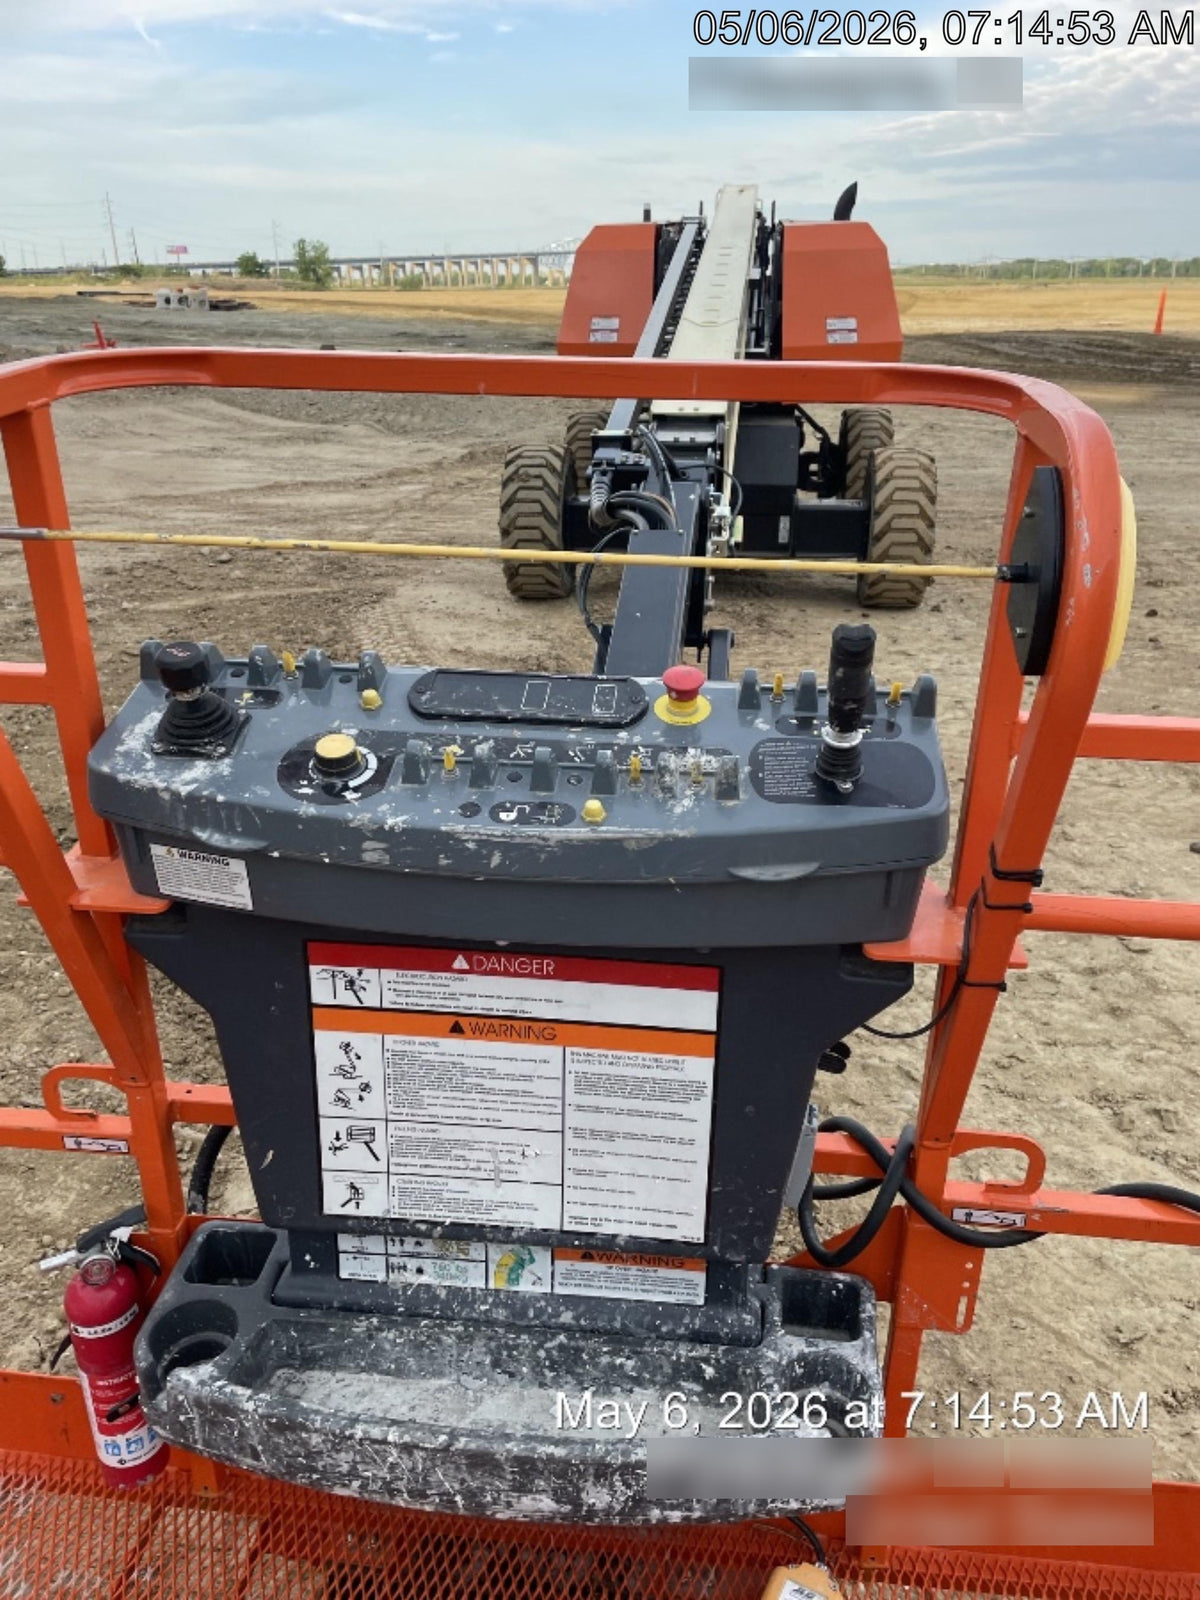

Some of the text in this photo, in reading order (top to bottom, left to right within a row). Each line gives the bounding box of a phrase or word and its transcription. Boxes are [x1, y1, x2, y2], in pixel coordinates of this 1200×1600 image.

[178, 848, 230, 867] WARNING
[473, 954, 556, 976] DANGER
[468, 1020, 557, 1042] WARNING
[595, 1252, 685, 1268] WARNING
